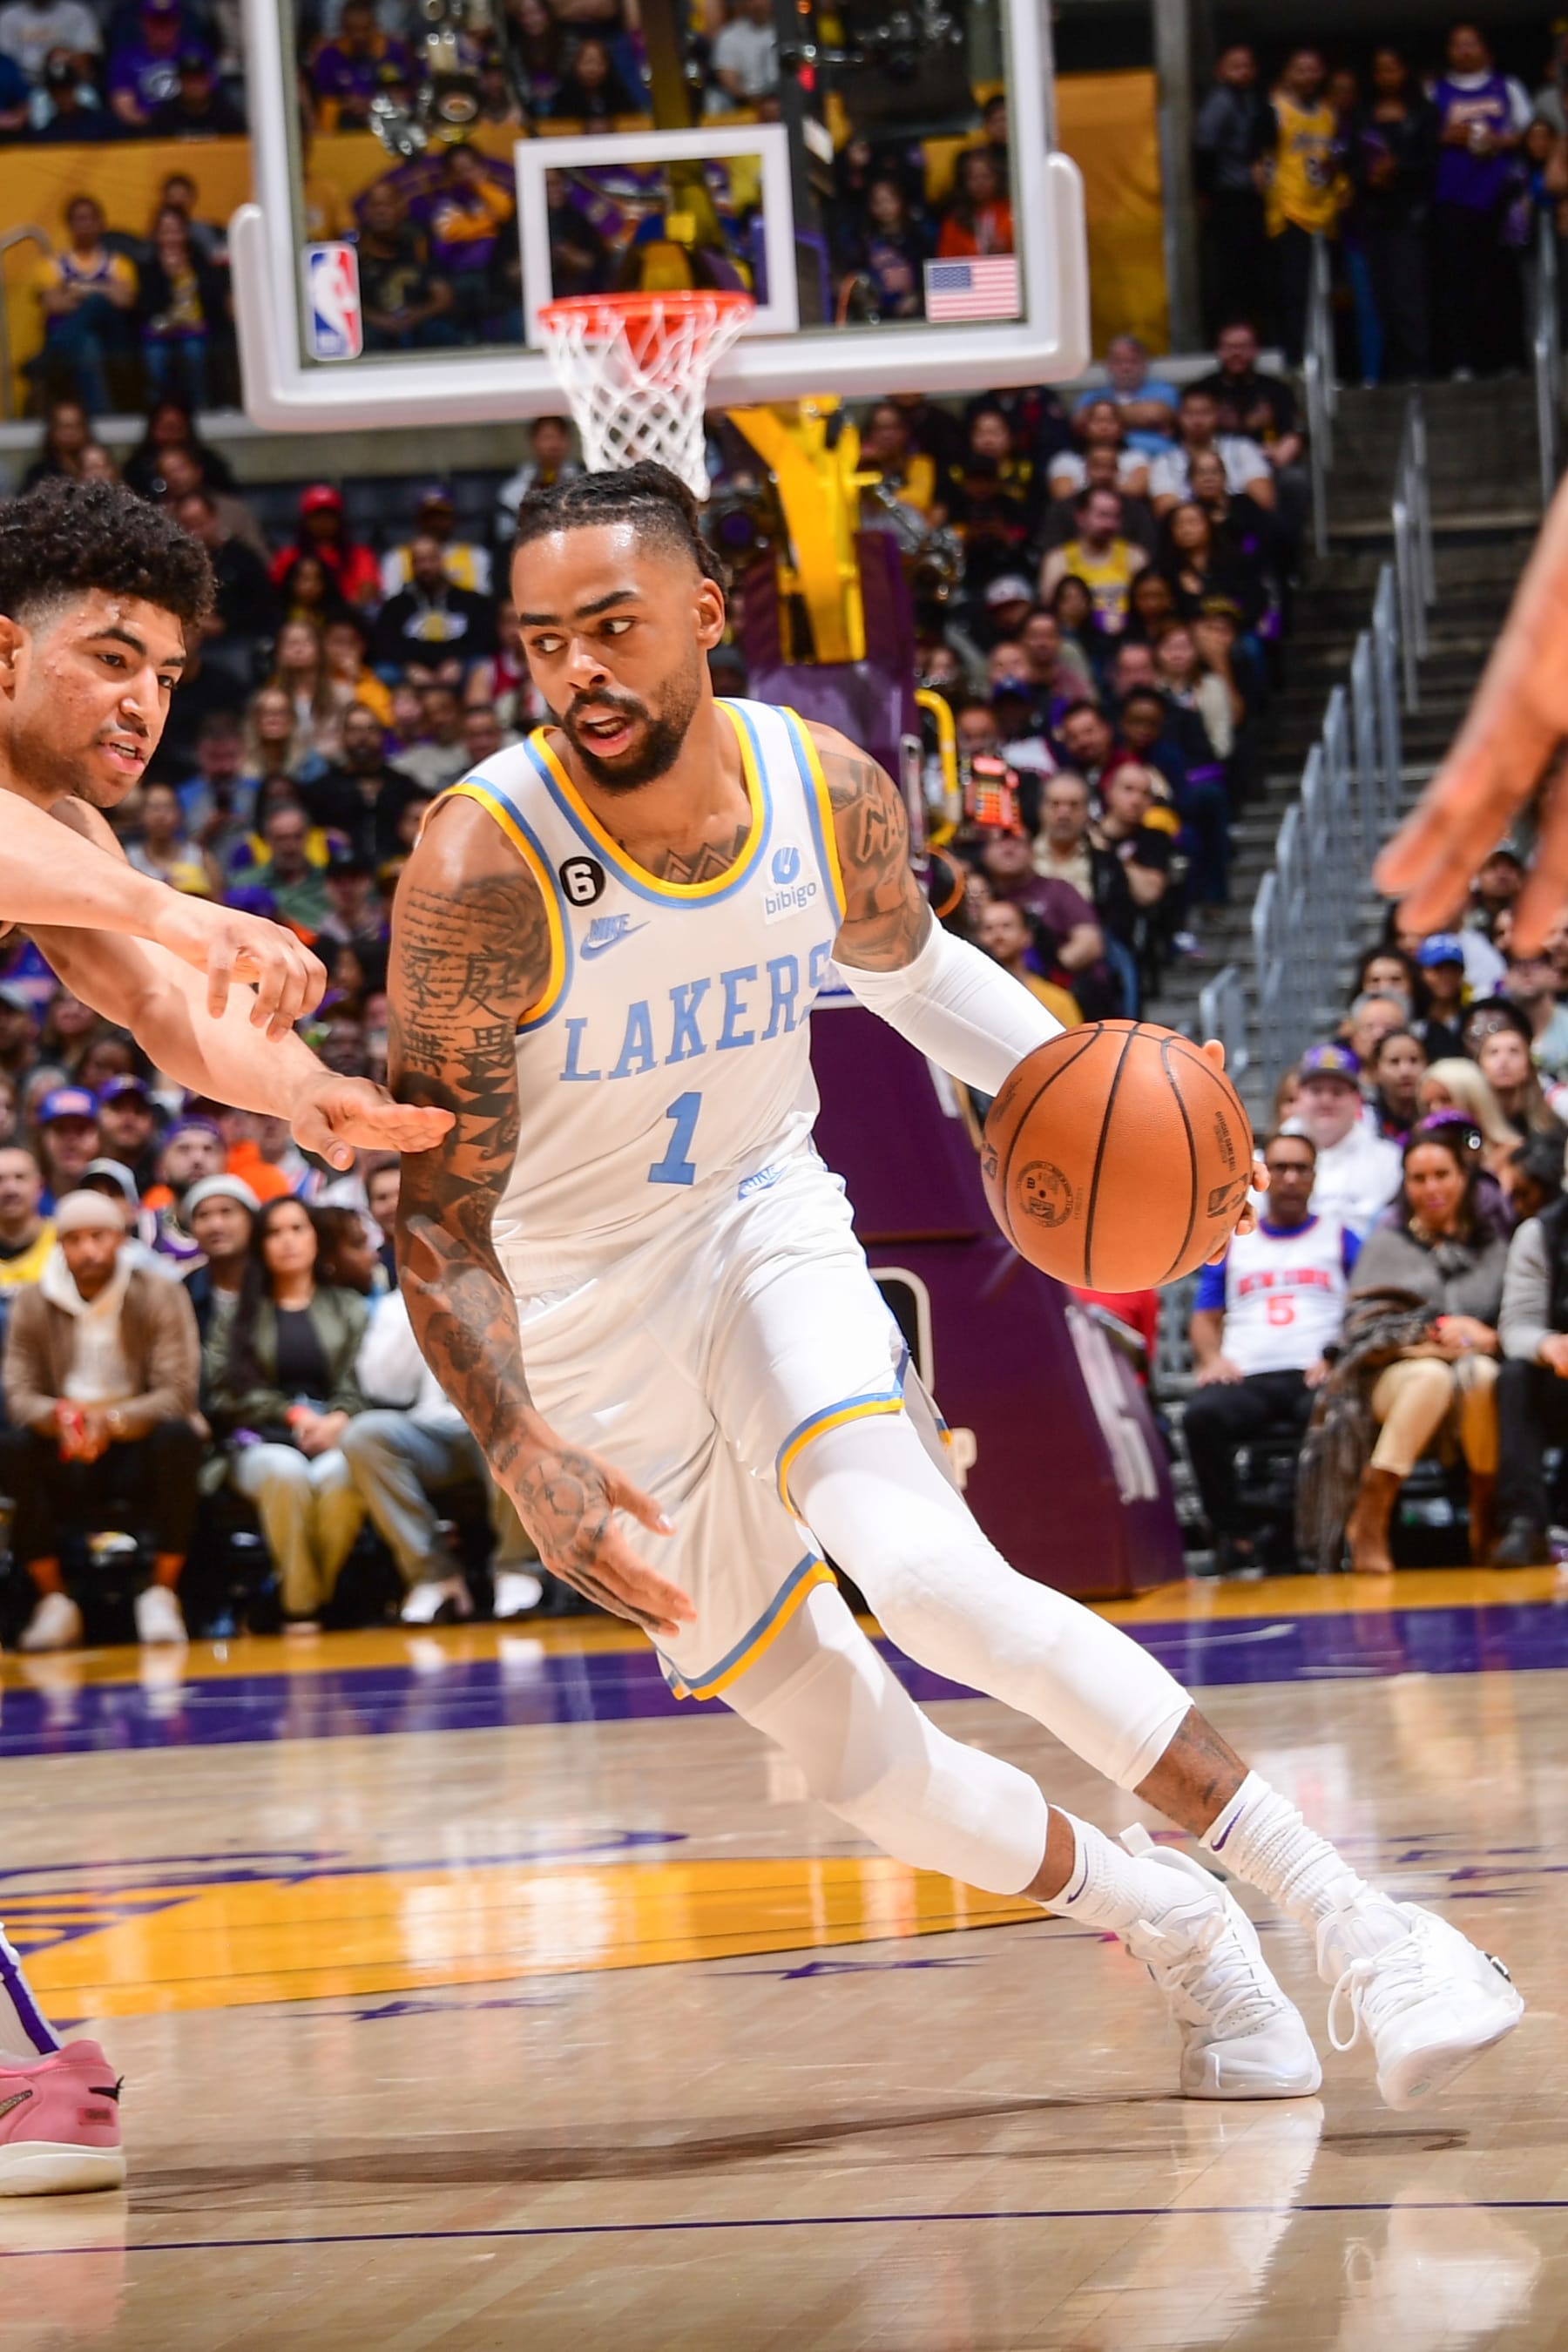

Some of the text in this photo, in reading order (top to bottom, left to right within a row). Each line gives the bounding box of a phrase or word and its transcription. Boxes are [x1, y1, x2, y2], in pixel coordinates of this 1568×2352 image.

[565, 862, 597, 902] 6
[765, 882, 817, 916] bibigo
[590, 913, 630, 942] NIKE
[647, 1092, 703, 1186] 1
[1267, 1294, 1295, 1326] 5
